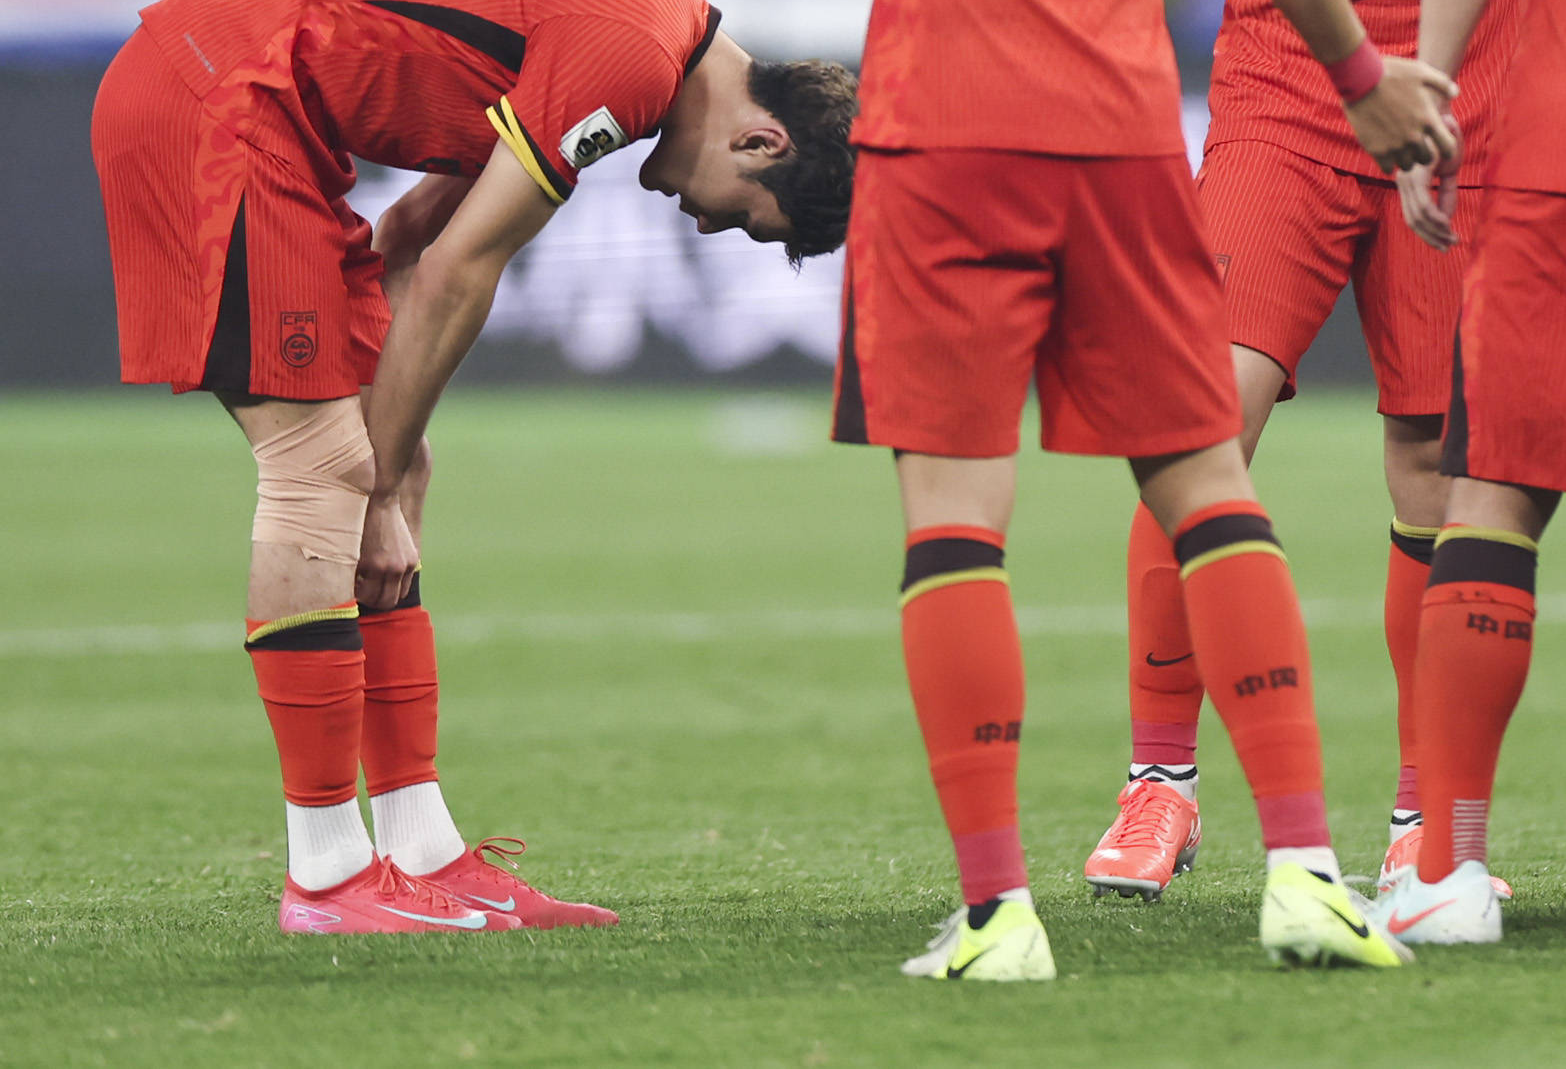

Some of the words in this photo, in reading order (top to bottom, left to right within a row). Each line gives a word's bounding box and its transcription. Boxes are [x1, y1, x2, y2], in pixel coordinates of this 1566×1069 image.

[284, 315, 315, 325] CFA
[1467, 612, 1532, 641] 中国
[1234, 667, 1298, 697] 中国
